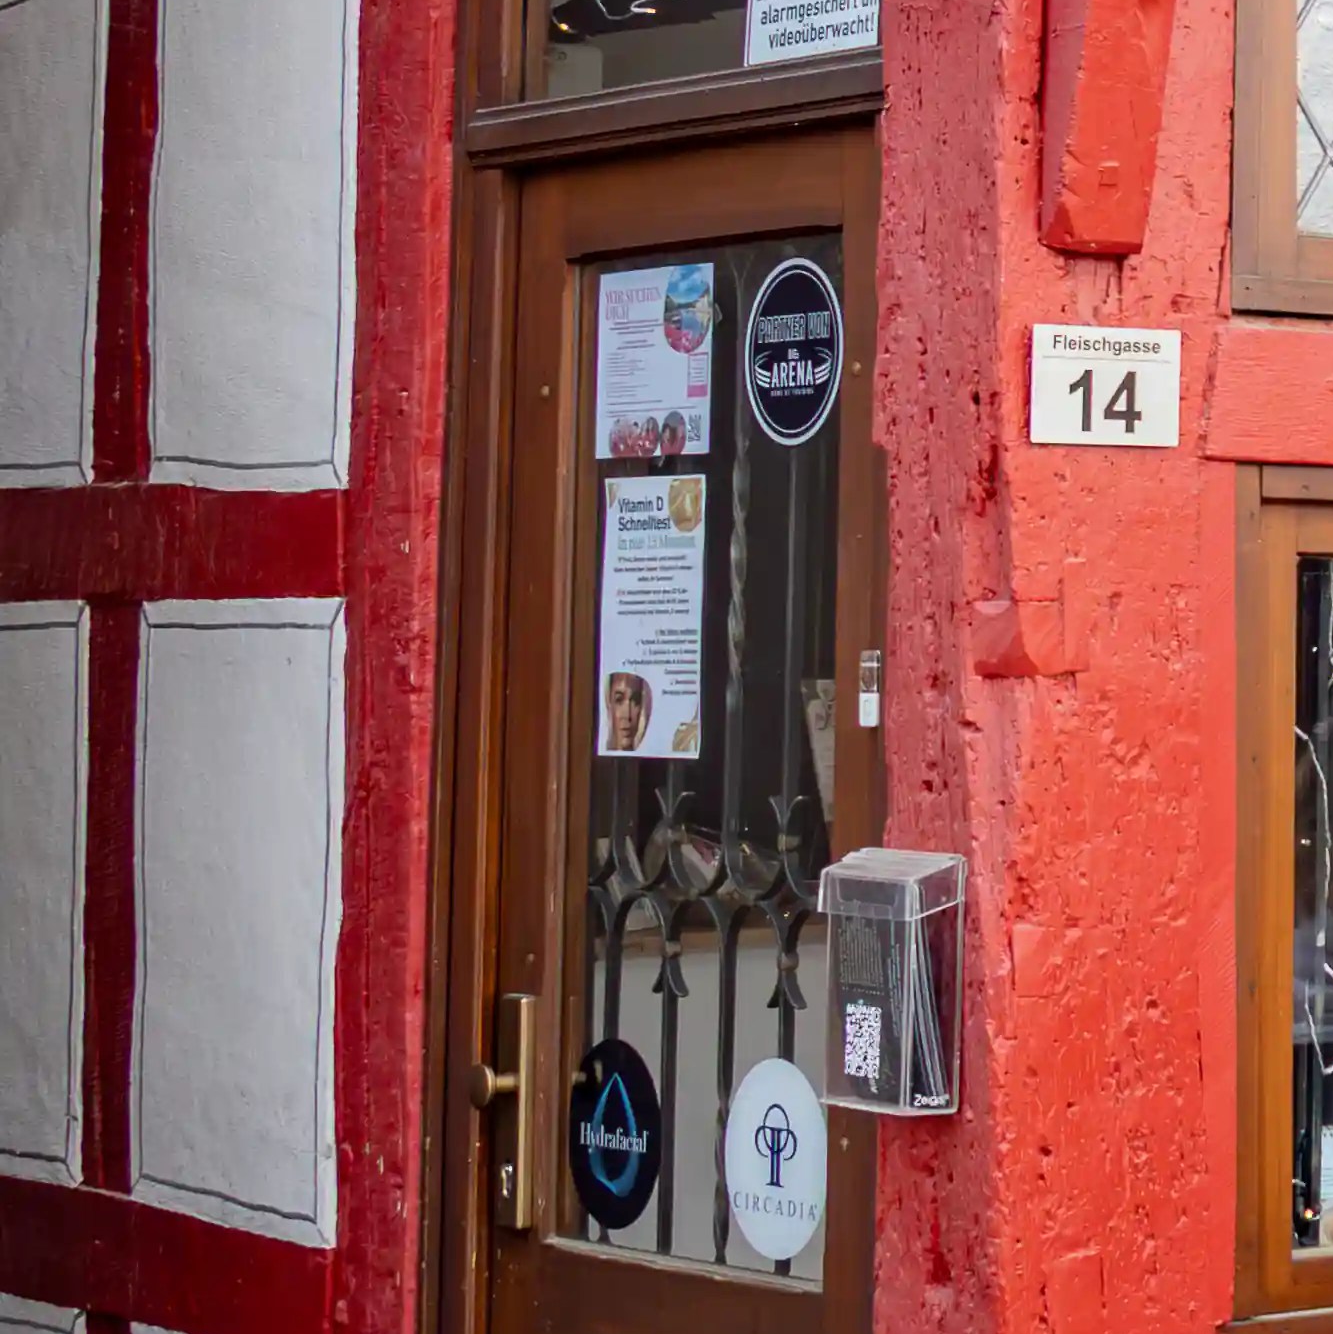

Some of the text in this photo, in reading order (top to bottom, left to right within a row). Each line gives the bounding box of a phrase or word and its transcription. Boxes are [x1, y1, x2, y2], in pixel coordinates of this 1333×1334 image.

[768, 12, 875, 50] videoüberwacht!
[757, 313, 806, 344] PARTNER
[1052, 334, 1162, 356] Fleischgasse
[771, 359, 814, 388] ARENA
[1068, 368, 1142, 434] 14
[617, 495, 664, 514] Vitamin D
[617, 514, 671, 532] Schnelltest
